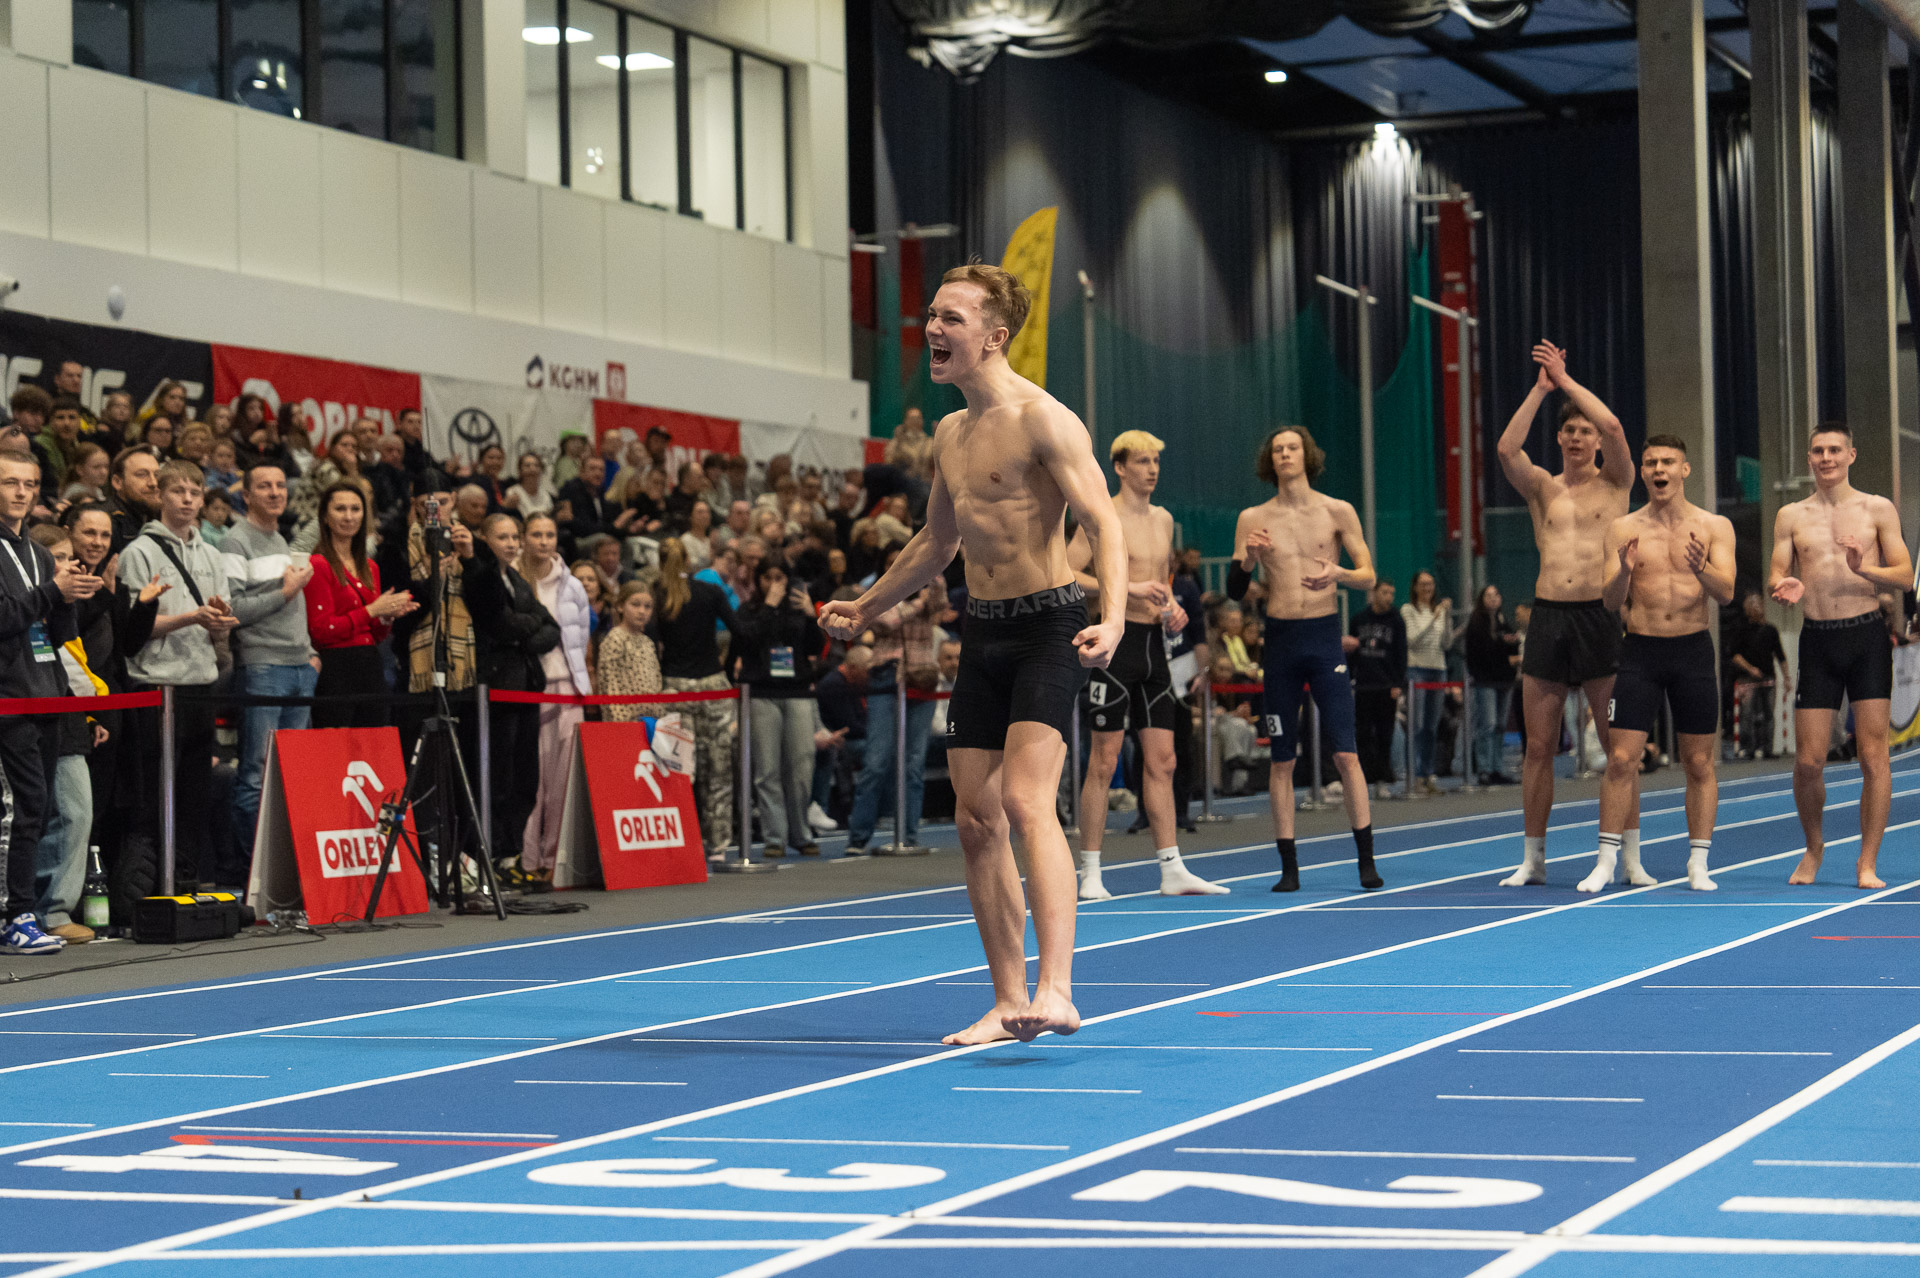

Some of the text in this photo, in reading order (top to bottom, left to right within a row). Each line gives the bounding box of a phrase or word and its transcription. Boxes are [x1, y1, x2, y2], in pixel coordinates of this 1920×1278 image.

[1092, 684, 1101, 703] 4
[1267, 716, 1277, 734] 8
[620, 814, 679, 843] ORLEN
[14, 1144, 399, 1176] 4
[526, 1157, 947, 1192] 3
[1070, 1169, 1544, 1209] 2
